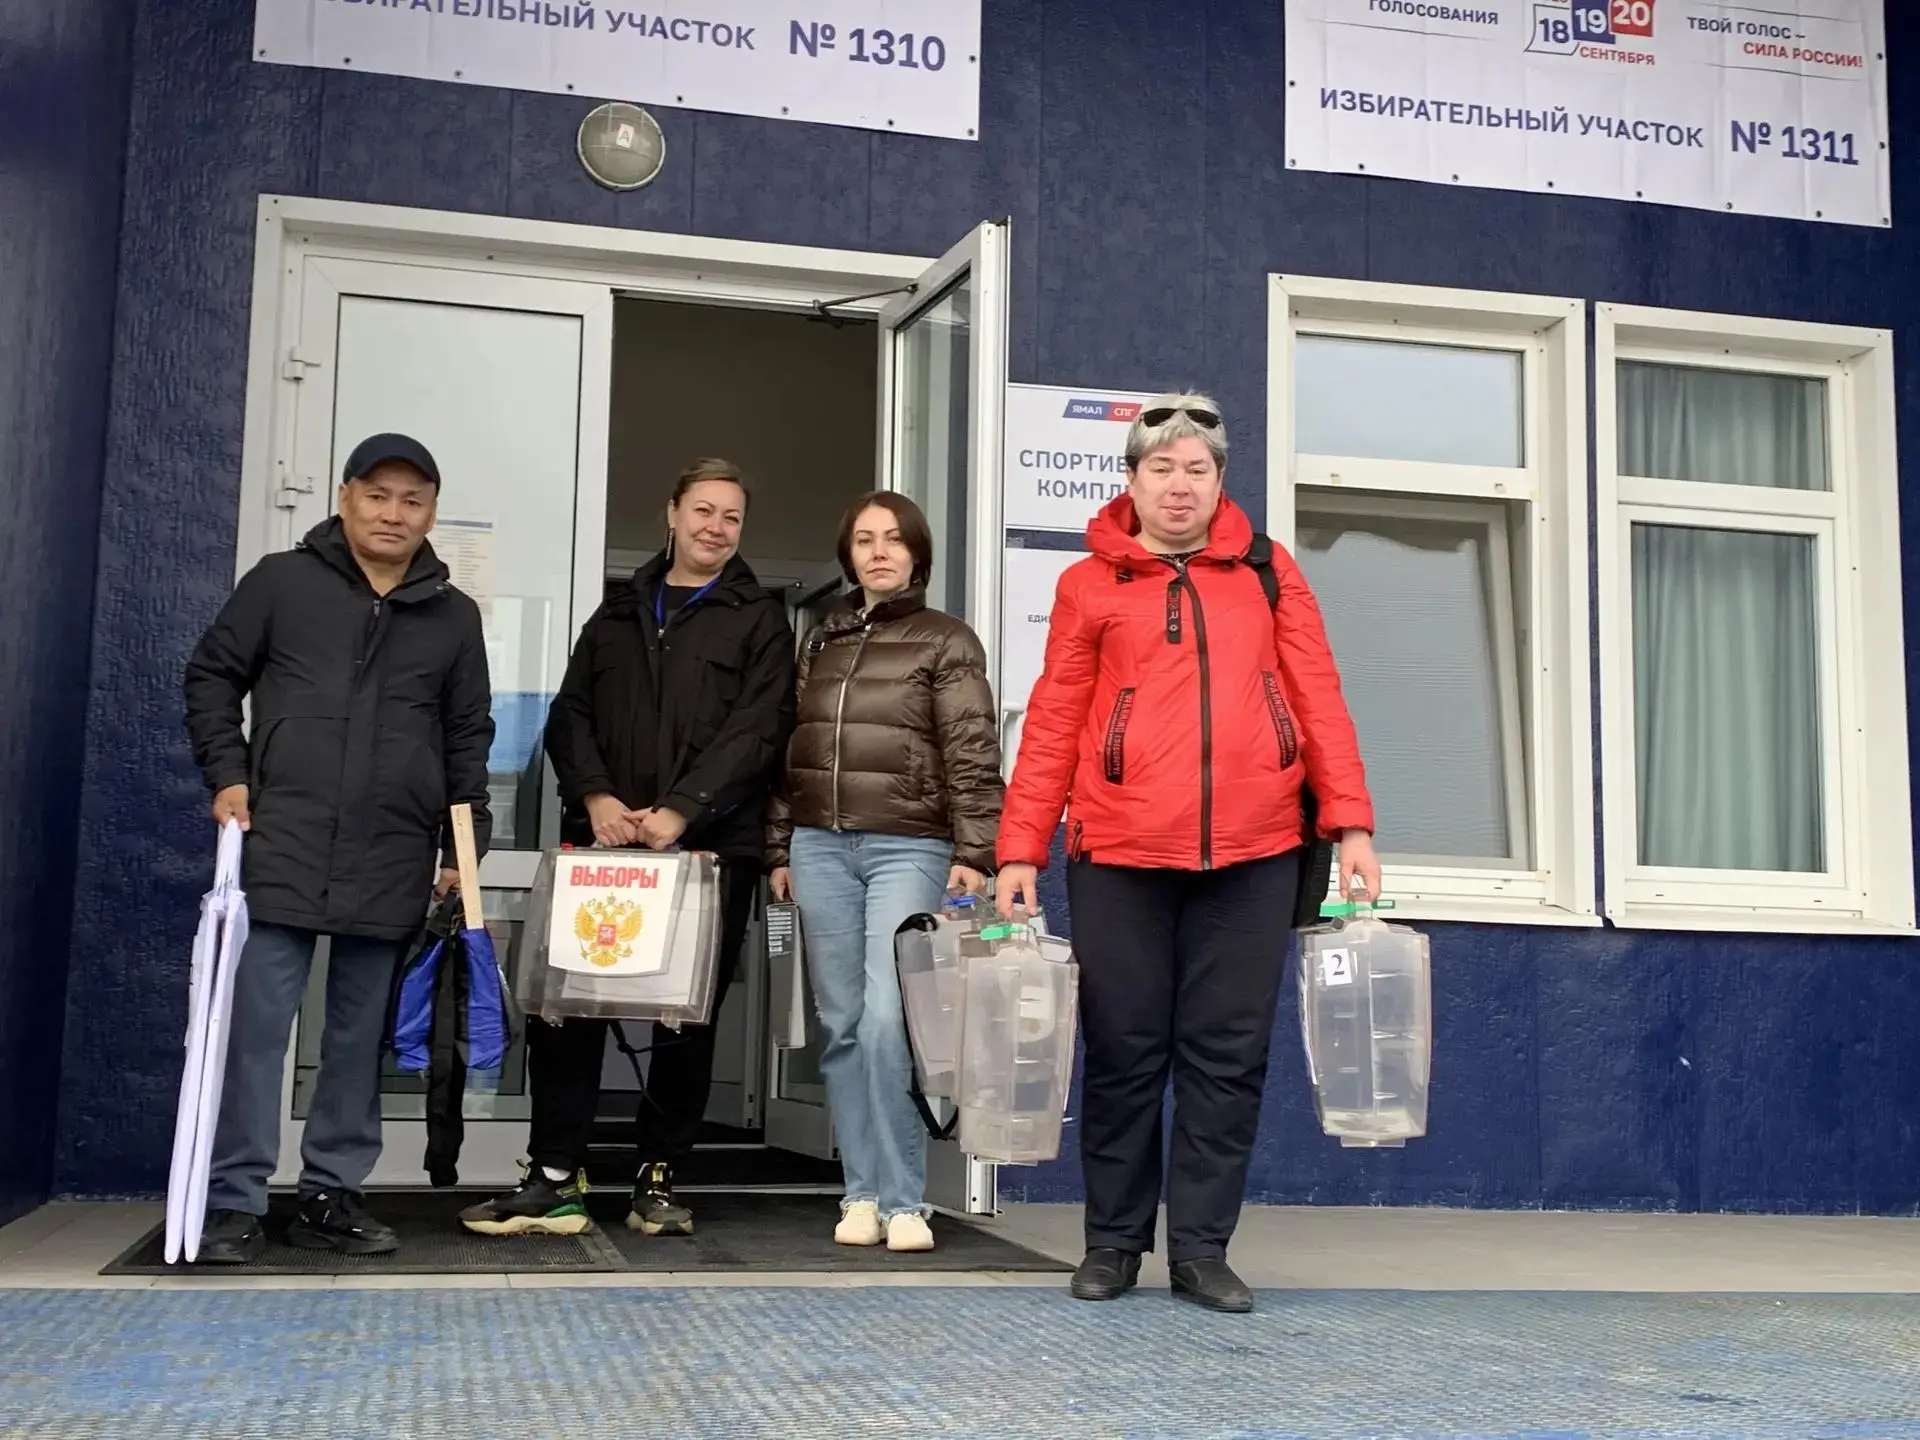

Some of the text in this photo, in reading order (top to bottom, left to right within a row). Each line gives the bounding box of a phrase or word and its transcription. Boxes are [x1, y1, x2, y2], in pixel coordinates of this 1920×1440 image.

[1369, 0, 1498, 25] ГОЛОСОВАНИЯ
[1539, 0, 1650, 43] 18 19 20
[330, 0, 946, 71] АТЕЛЬНЫЙ УЧАСТОК № 1310
[1687, 16, 1732, 34] ТВОЙ
[1737, 22, 1791, 39] ГОЛОС
[1580, 46, 1655, 65] СЕНТЯБРЯ
[1743, 41, 1863, 67] СИЛА РОССИИ!
[1319, 87, 1860, 165] ИЗБИРАТЕЛЬНЫЙ УЧАСТОК № 1311
[1072, 404, 1134, 417] ЯМАЛ СПГ
[1037, 479, 1129, 501] КОМПЛ
[1028, 614, 1050, 624] ЕДИ
[570, 865, 659, 889] ВЫБОРЫ
[1332, 954, 1344, 976] 2
